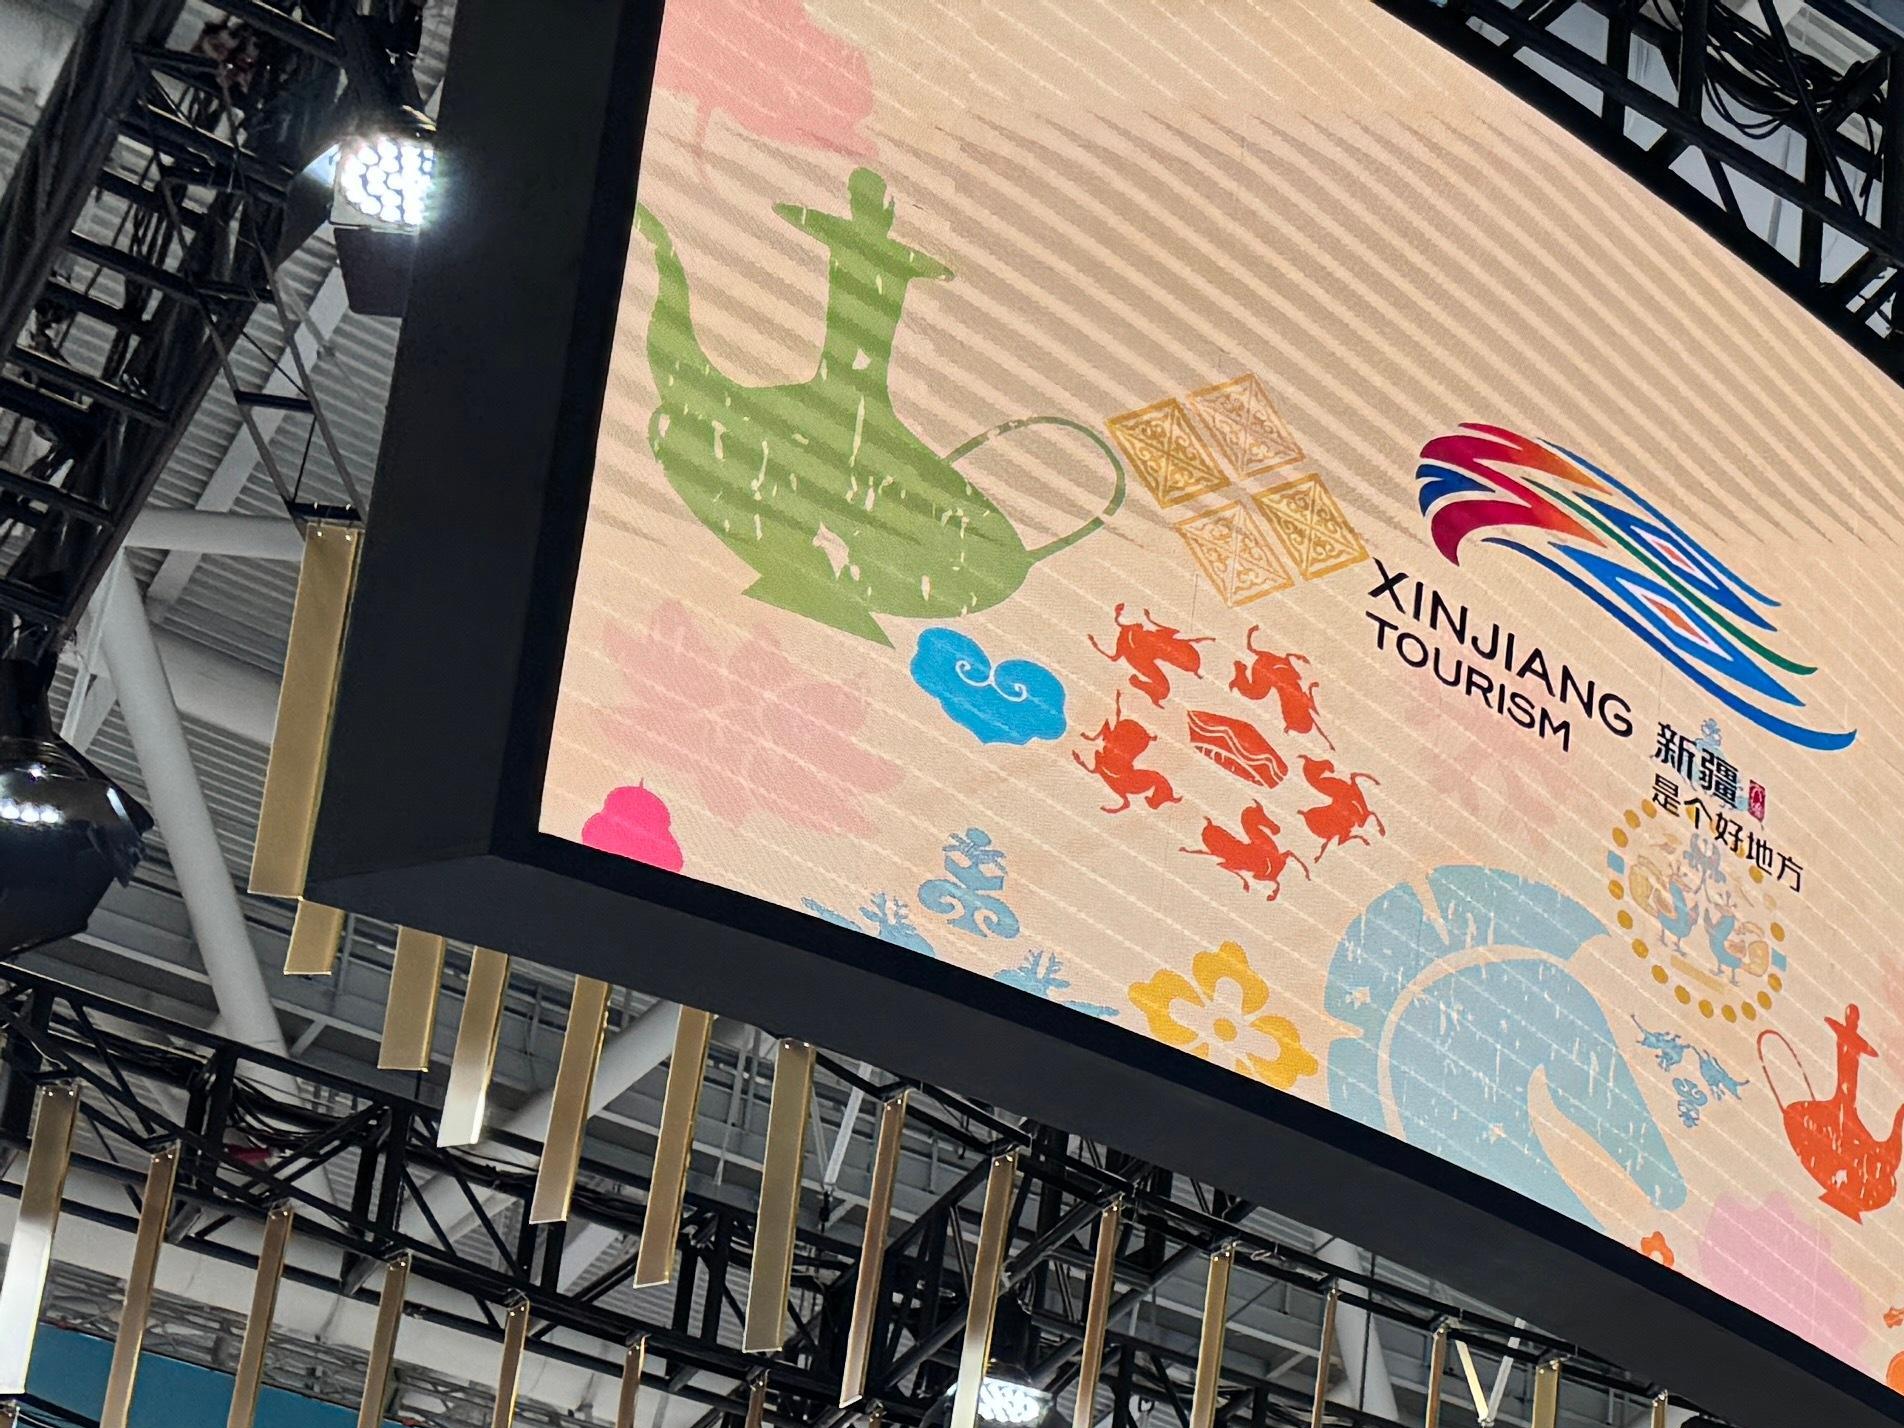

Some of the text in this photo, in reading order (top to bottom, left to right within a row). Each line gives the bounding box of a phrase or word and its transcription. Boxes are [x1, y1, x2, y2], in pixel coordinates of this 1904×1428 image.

[1365, 610, 1573, 753] TOURISM
[1367, 556, 1634, 738] XINJIANG
[1652, 720, 1740, 810] 新疆
[1652, 772, 1804, 893] 是个好地方
